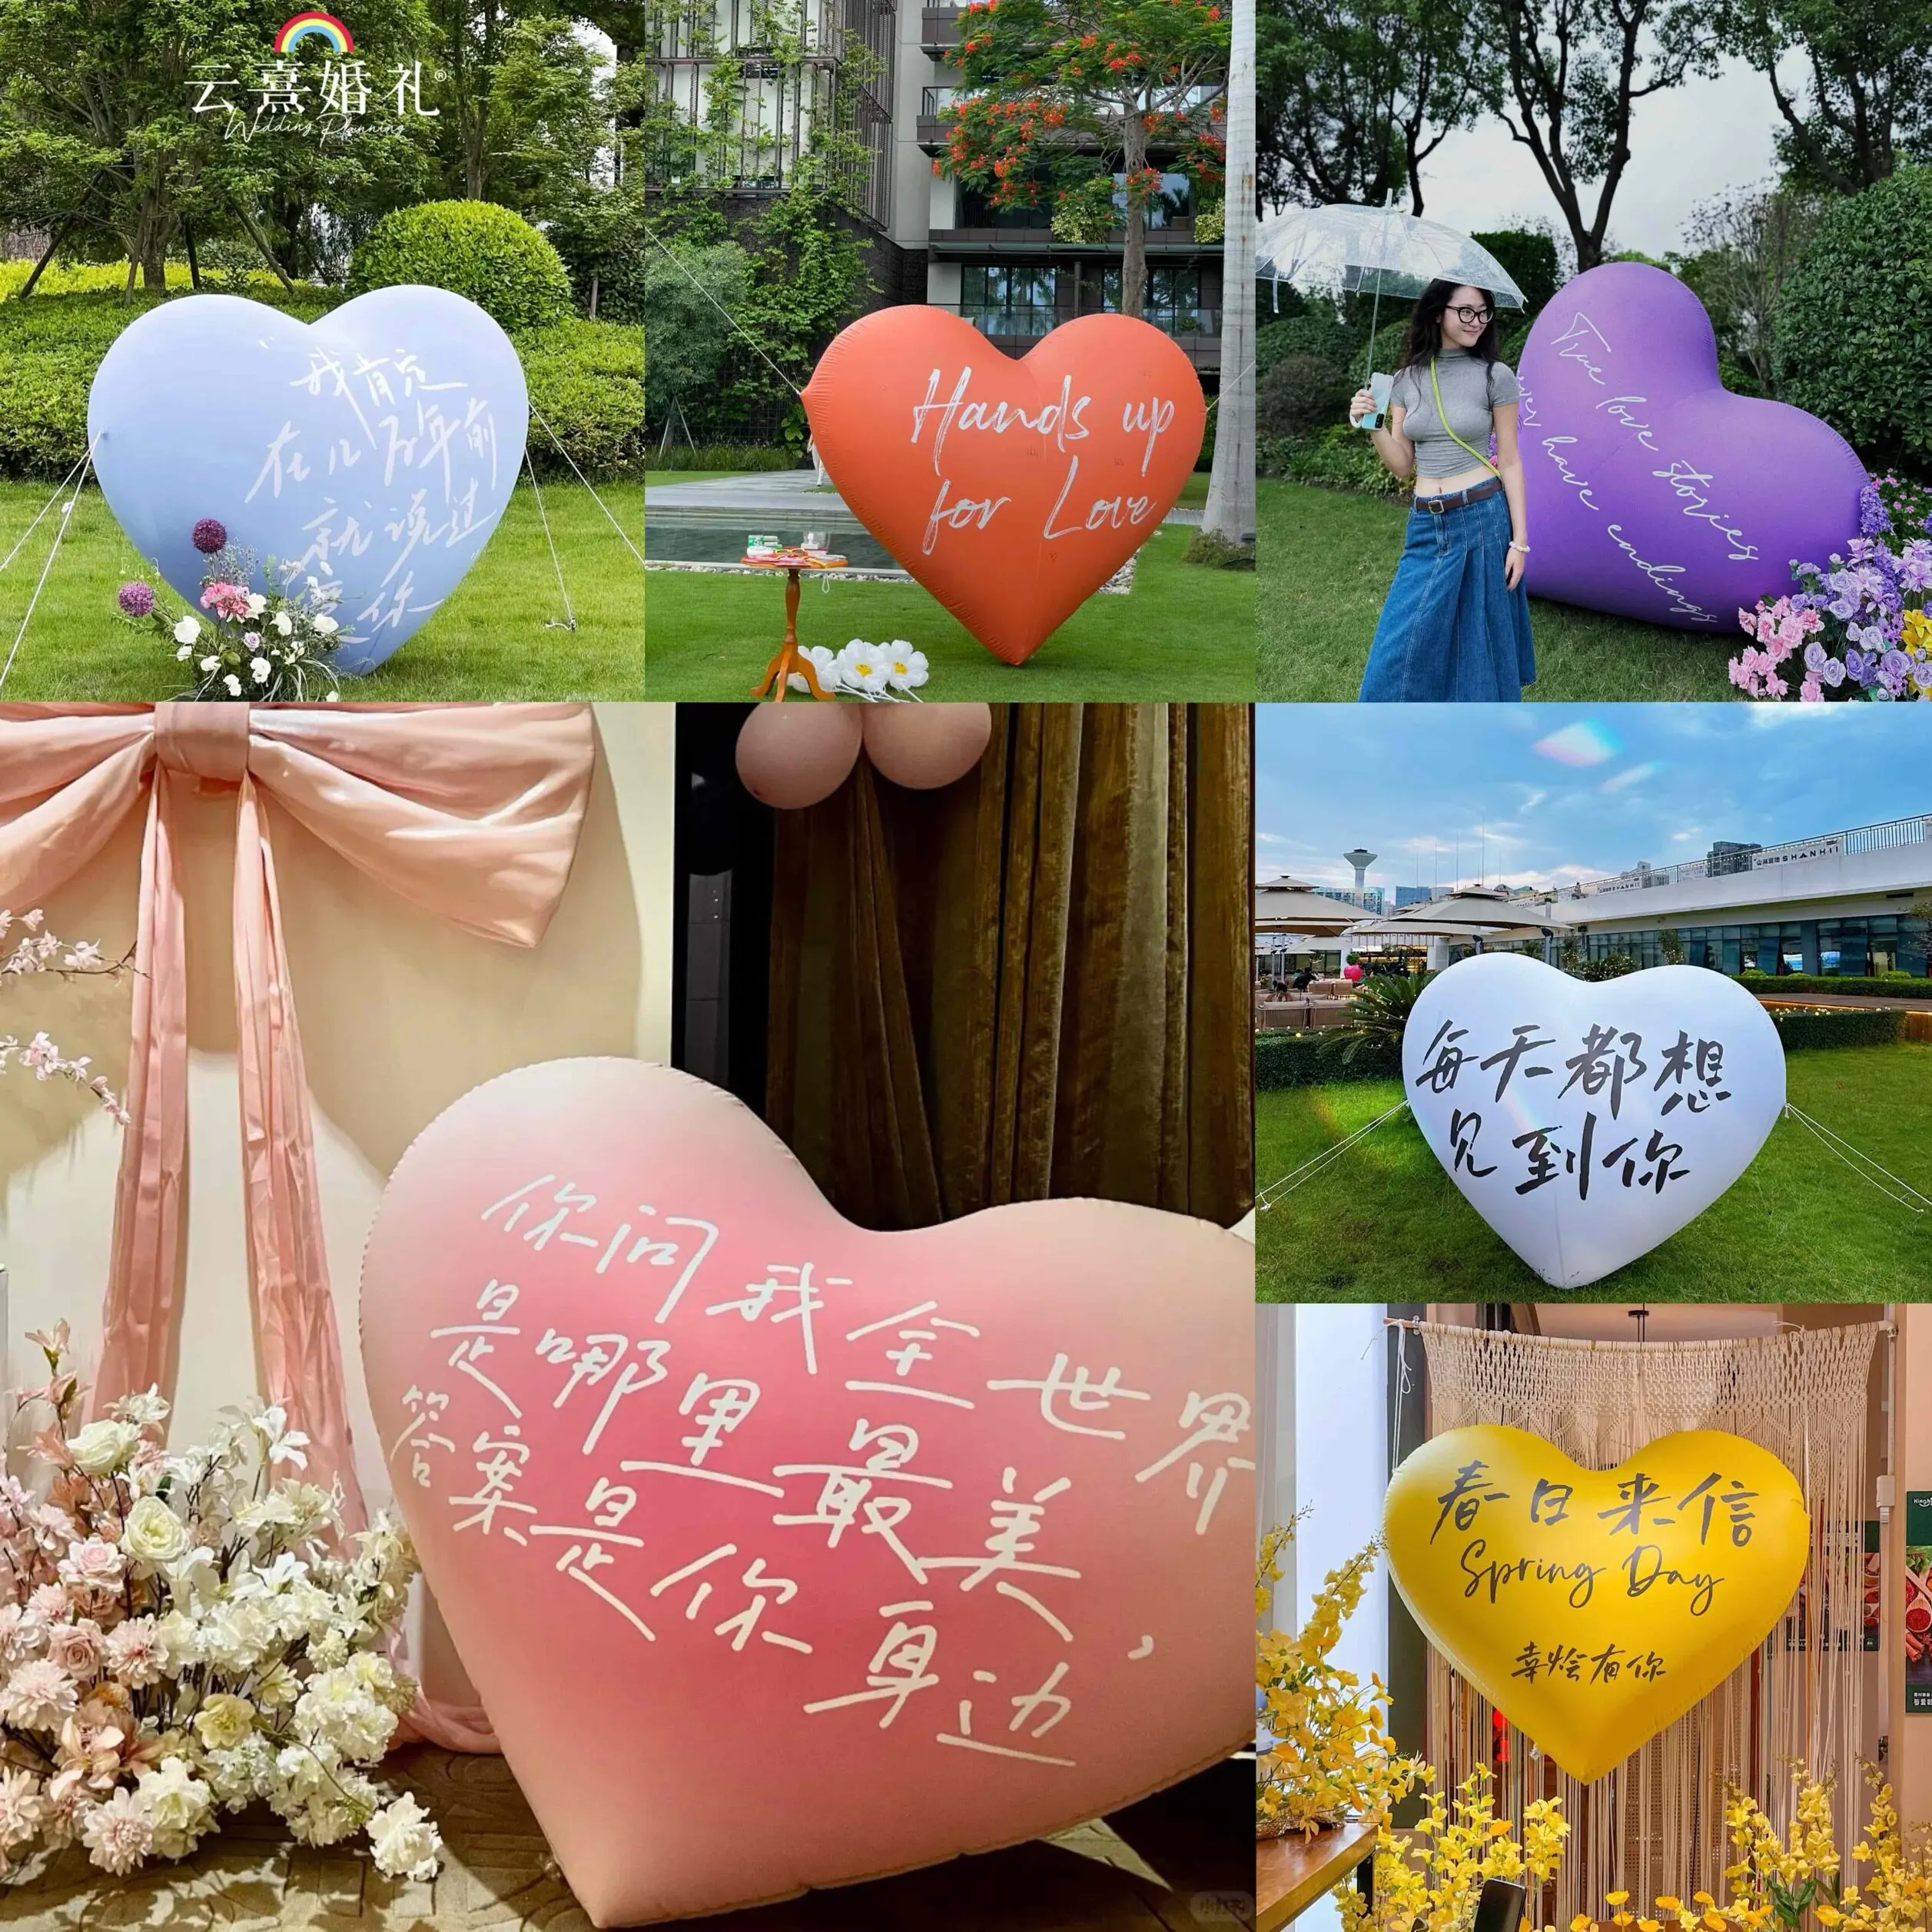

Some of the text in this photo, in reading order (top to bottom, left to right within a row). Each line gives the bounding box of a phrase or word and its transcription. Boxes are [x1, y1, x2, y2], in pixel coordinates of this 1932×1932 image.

[911, 366, 1175, 476] Hands up
[1551, 312, 1759, 560] True love stories
[922, 455, 1157, 556] for Love
[1542, 436, 1598, 510] have
[1608, 524, 1718, 623] endings
[1416, 1019, 1731, 1120] 每天都想
[1449, 1108, 1691, 1200] 见到你
[482, 1173, 1256, 1535] 你问我全世界
[1429, 1459, 1759, 1547] 春日来信
[390, 1384, 1076, 1766] 答案是你身边
[1460, 1539, 1725, 1616] Spring Day
[1511, 1641, 1667, 1685] 幸烩有你
